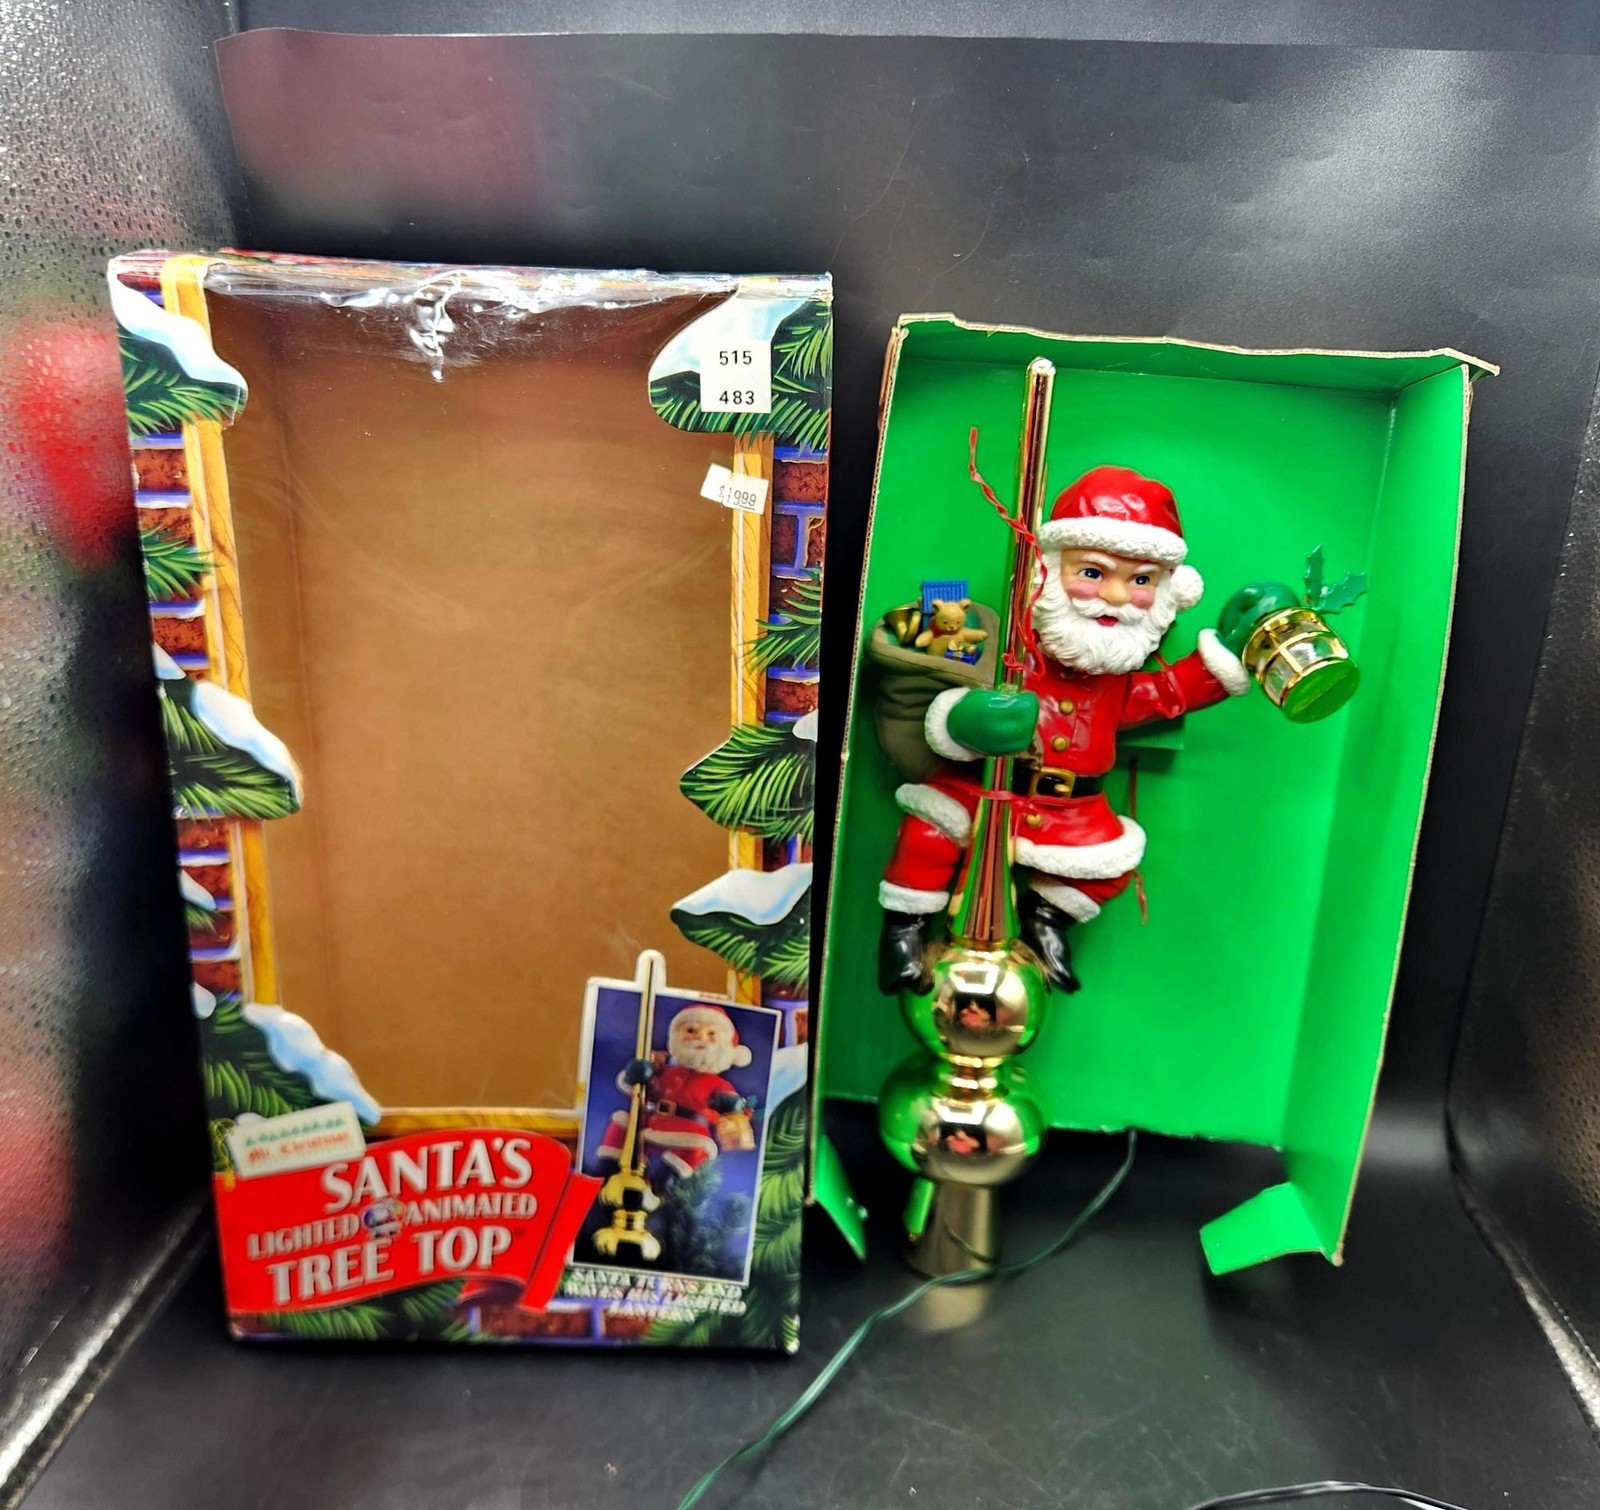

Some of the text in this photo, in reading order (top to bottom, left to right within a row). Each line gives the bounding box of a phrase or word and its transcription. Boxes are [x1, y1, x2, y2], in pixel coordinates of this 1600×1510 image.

[719, 350, 752, 365] 515
[719, 390, 755, 405] 483
[320, 1137, 533, 1213] SANTA'S
[247, 1192, 538, 1260] LIGHTED ANIMATED
[266, 1225, 512, 1306] TREE TOP
[570, 1269, 631, 1287] SANTA
